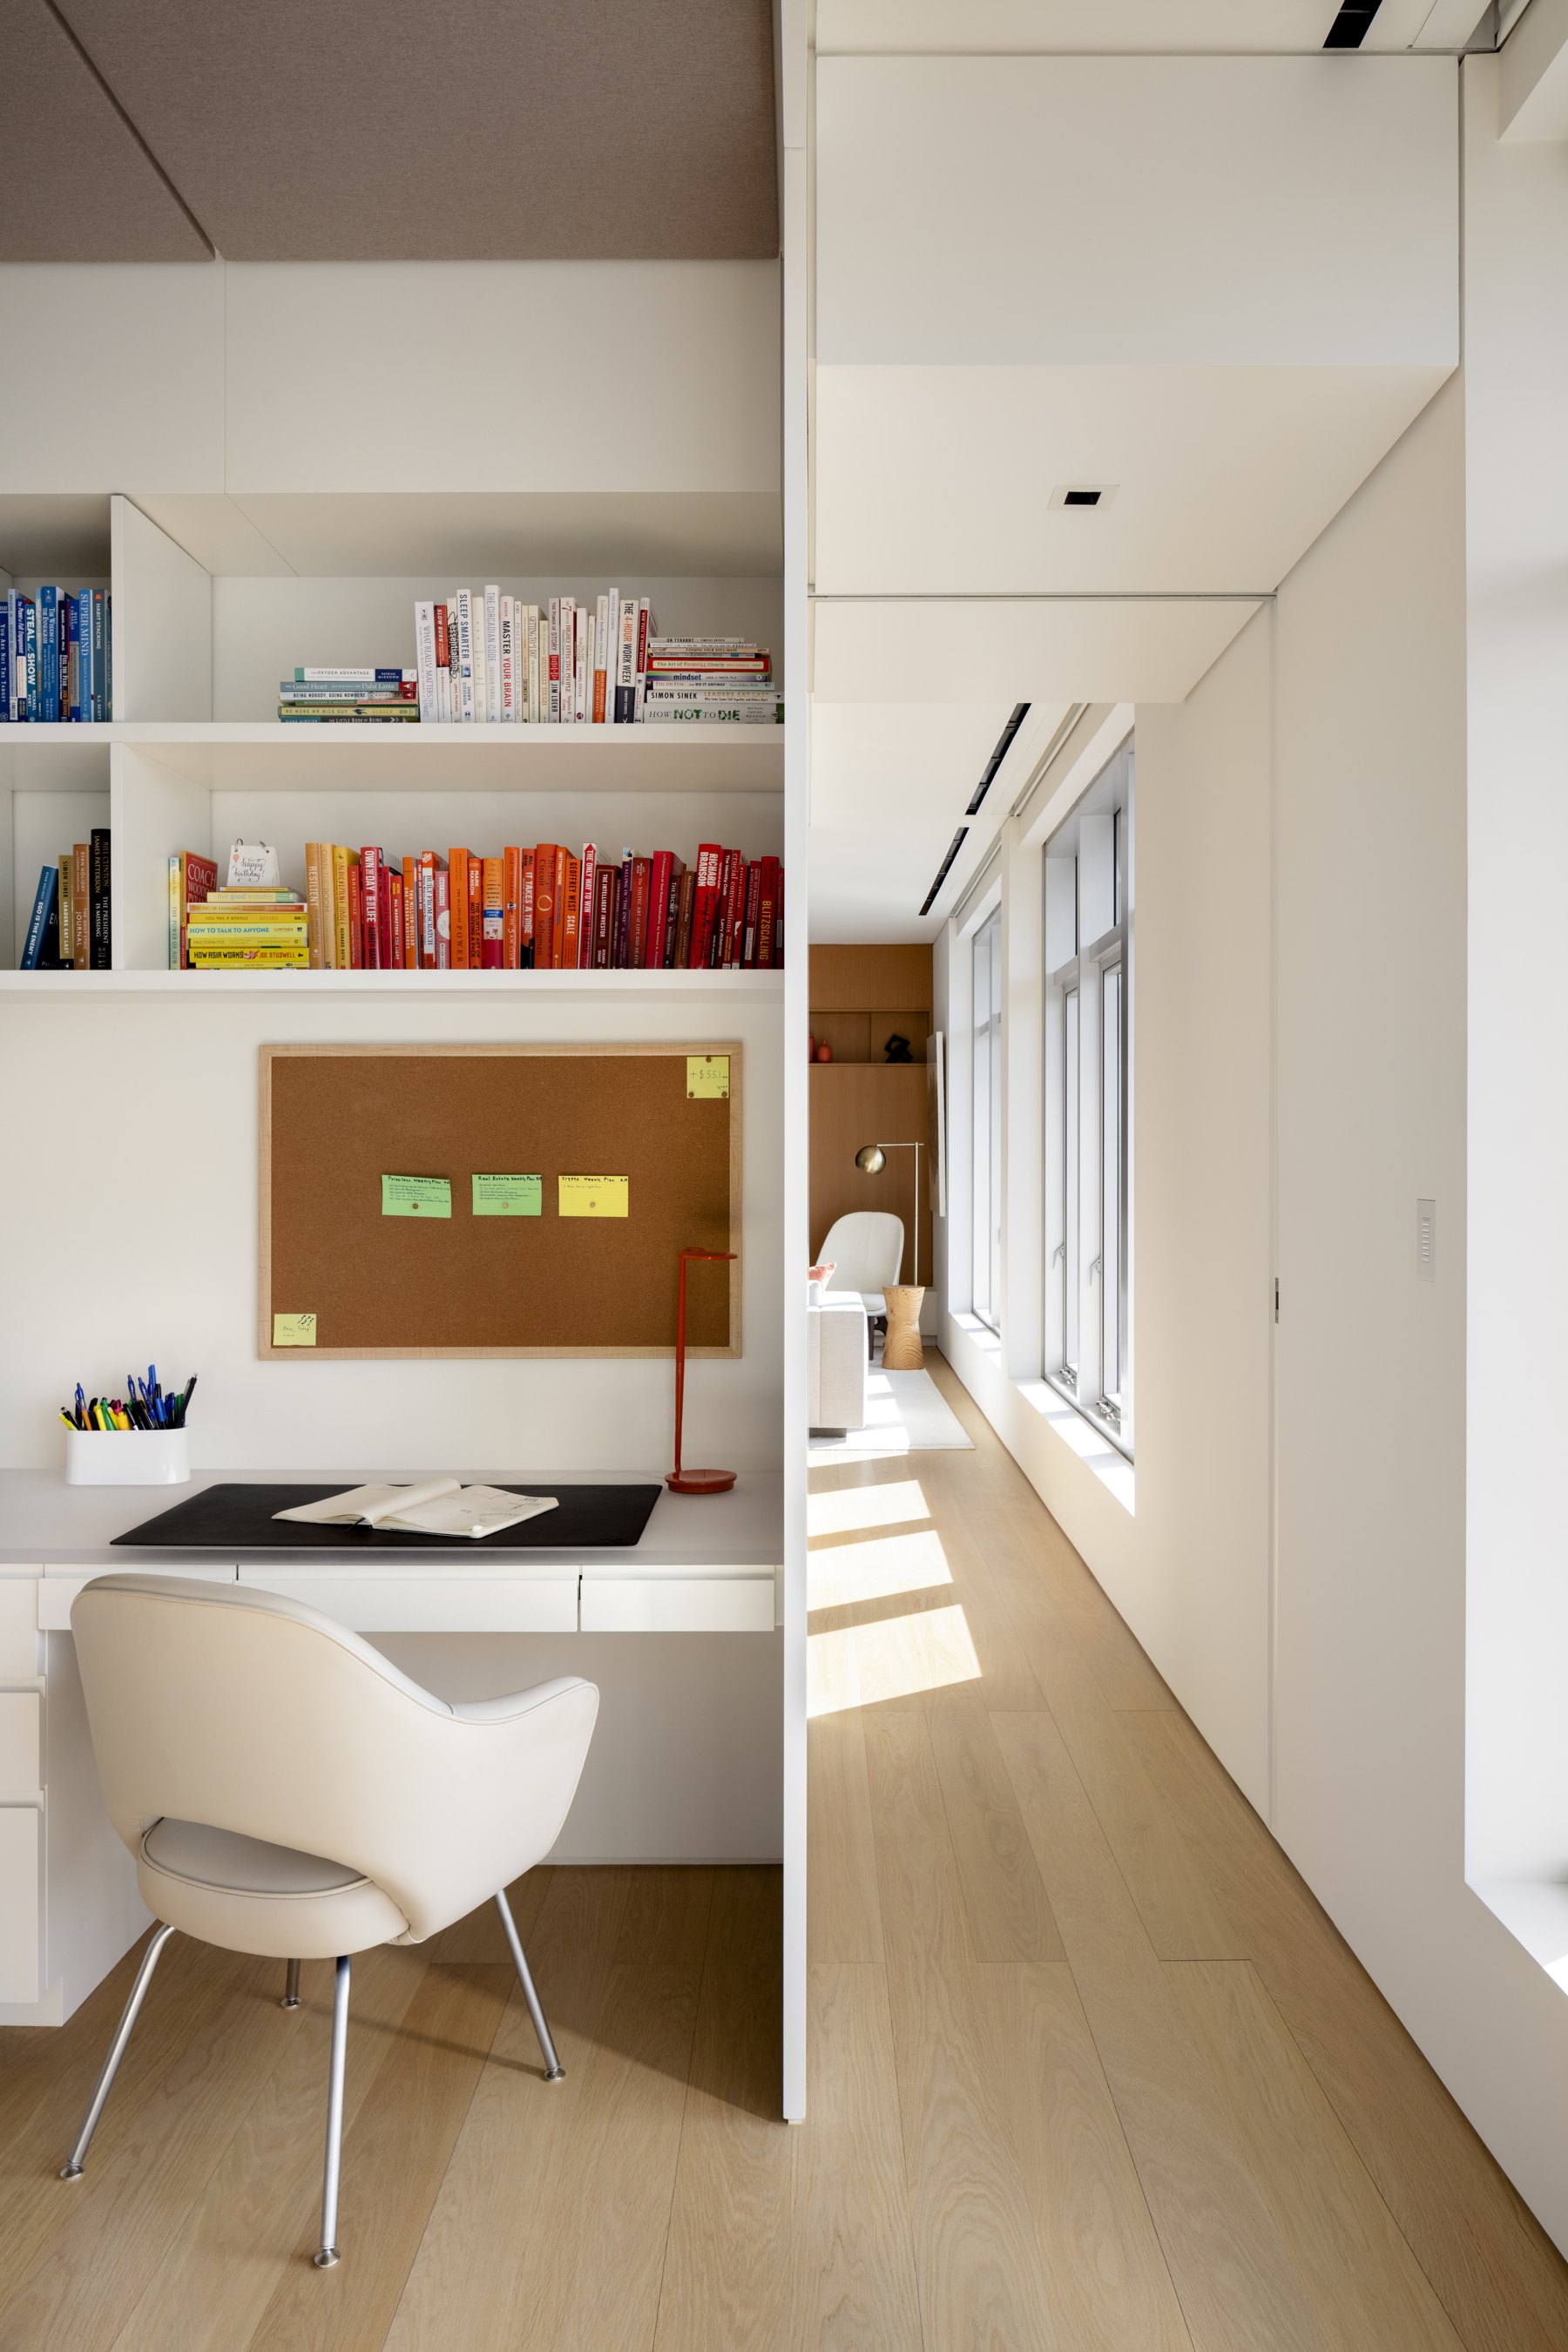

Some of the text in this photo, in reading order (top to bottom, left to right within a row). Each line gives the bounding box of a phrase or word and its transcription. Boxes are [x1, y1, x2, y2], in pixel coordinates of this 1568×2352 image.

[80, 594, 89, 628] SUPER
[460, 594, 469, 659] SLEEP SMARTER
[487, 592, 496, 662] THE CIRCADIAN CODE
[80, 629, 89, 656] MIND
[622, 603, 633, 683] THE 4-HOUR WORK WEEK
[423, 625, 433, 697] WHAT REALLY MATTERS
[502, 620, 512, 708] MASTER YOUR BRAIN
[673, 709, 702, 720] NOT
[718, 710, 740, 721] DIE
[242, 858, 263, 871] happy
[365, 850, 375, 868] OWN
[697, 852, 709, 887] BRANSON
[707, 853, 718, 886] RICHARD
[188, 864, 217, 888] COACH
[308, 866, 319, 906] RESILIENT
[366, 876, 375, 891] DAY
[525, 881, 533, 903] TAKES
[568, 862, 578, 912] GEOFFREY WEST
[366, 907, 376, 922] LIFE
[726, 881, 735, 933] conversations
[524, 914, 532, 934] TRIBE
[536, 919, 544, 955] Seligman
[566, 915, 575, 934] SCALE
[759, 900, 772, 960] BLITZSCALING
[28, 935, 37, 955] ENEMY
[475, 950, 479, 958] OF
